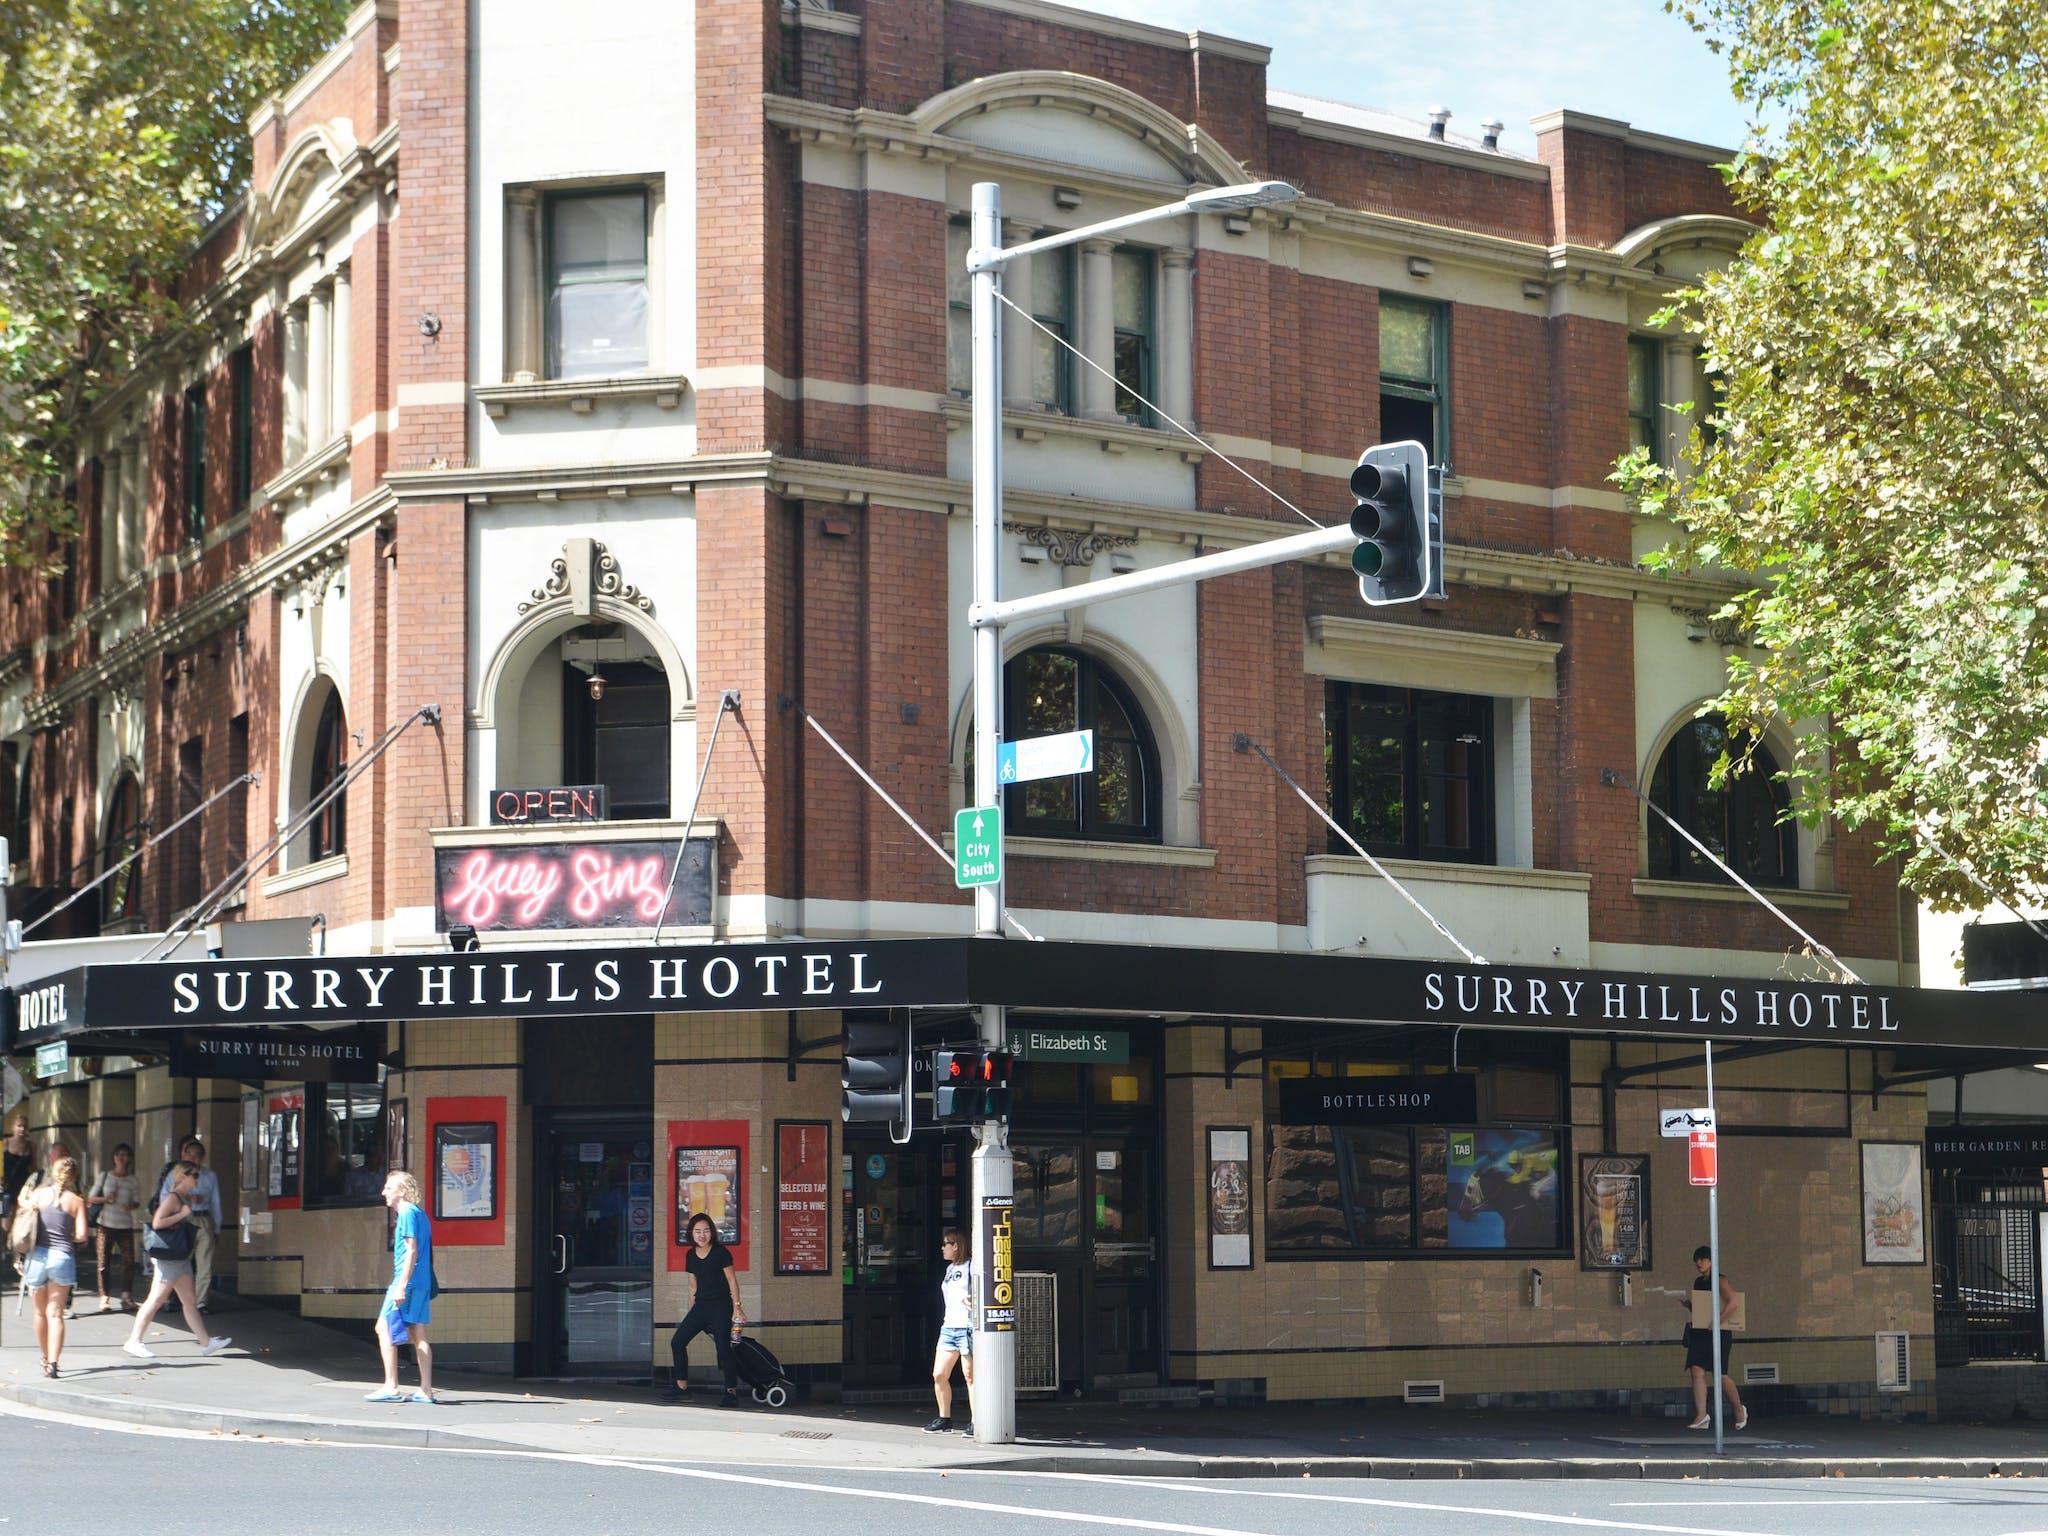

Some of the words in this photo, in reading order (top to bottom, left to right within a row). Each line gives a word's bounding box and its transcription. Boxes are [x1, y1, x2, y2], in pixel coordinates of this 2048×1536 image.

[496, 789, 594, 820] OPEN
[966, 843, 990, 858] City
[962, 864, 995, 877] South
[173, 967, 394, 1013] SURRY
[417, 960, 621, 1006] HILLS
[649, 953, 883, 999] HOTEL
[19, 983, 67, 1031] HOTEL
[1425, 973, 1585, 1017] SURRY
[1602, 983, 1738, 1024] HILLS
[1755, 990, 1899, 1031] HOTEL
[1030, 1033, 1090, 1051] Elizabeth
[1093, 1035, 1107, 1051] St
[199, 1041, 253, 1056] SURRY
[259, 1043, 306, 1058] HILLS
[312, 1045, 364, 1059] HOTEL
[1323, 1093, 1431, 1108] BOTTLESHOP
[1454, 1145, 1471, 1155] TAB
[1934, 1141, 1966, 1153] BEER
[1969, 1140, 2021, 1152] GARDEN
[780, 1183, 812, 1193] SELECTED
[813, 1183, 827, 1193] TAP
[781, 1201, 802, 1211] BEERS
[809, 1201, 826, 1211] WINE
